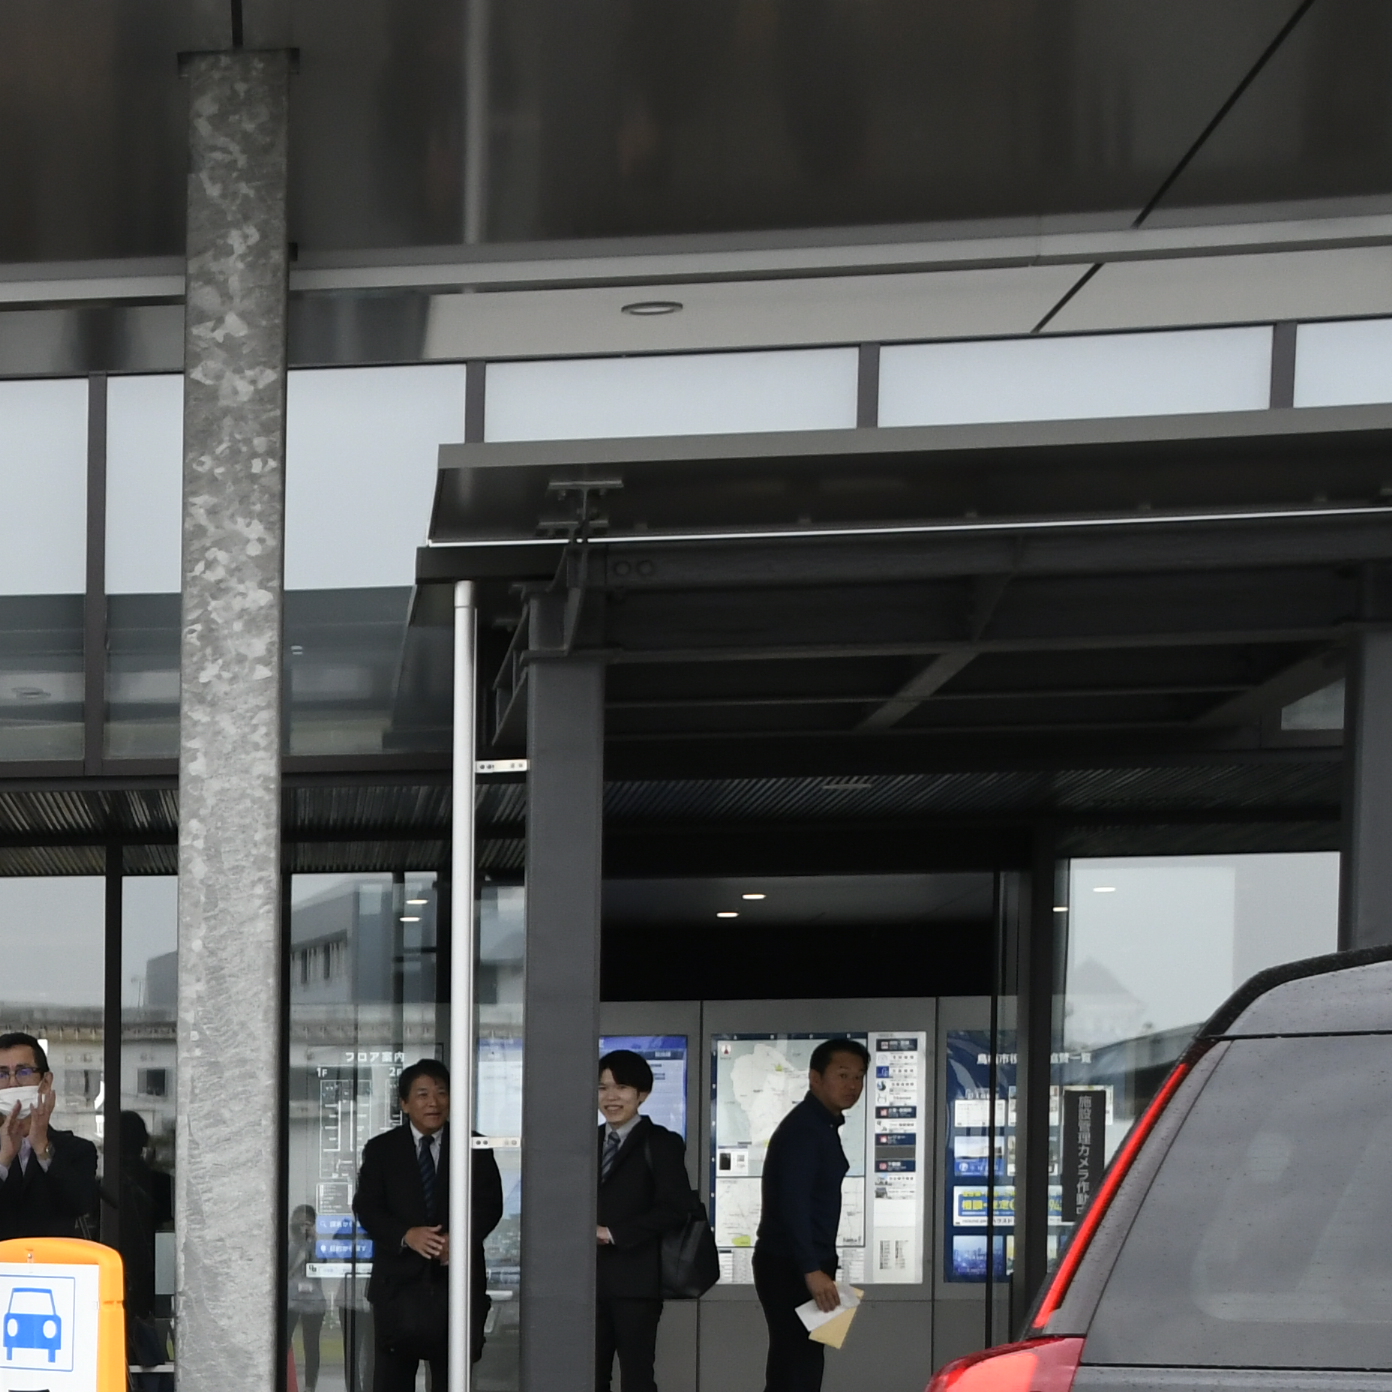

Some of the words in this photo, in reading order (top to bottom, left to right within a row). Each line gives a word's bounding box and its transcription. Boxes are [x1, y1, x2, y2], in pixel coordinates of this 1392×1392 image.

[345, 1051, 405, 1062] フロア案内
[317, 1067, 328, 1078] 1F
